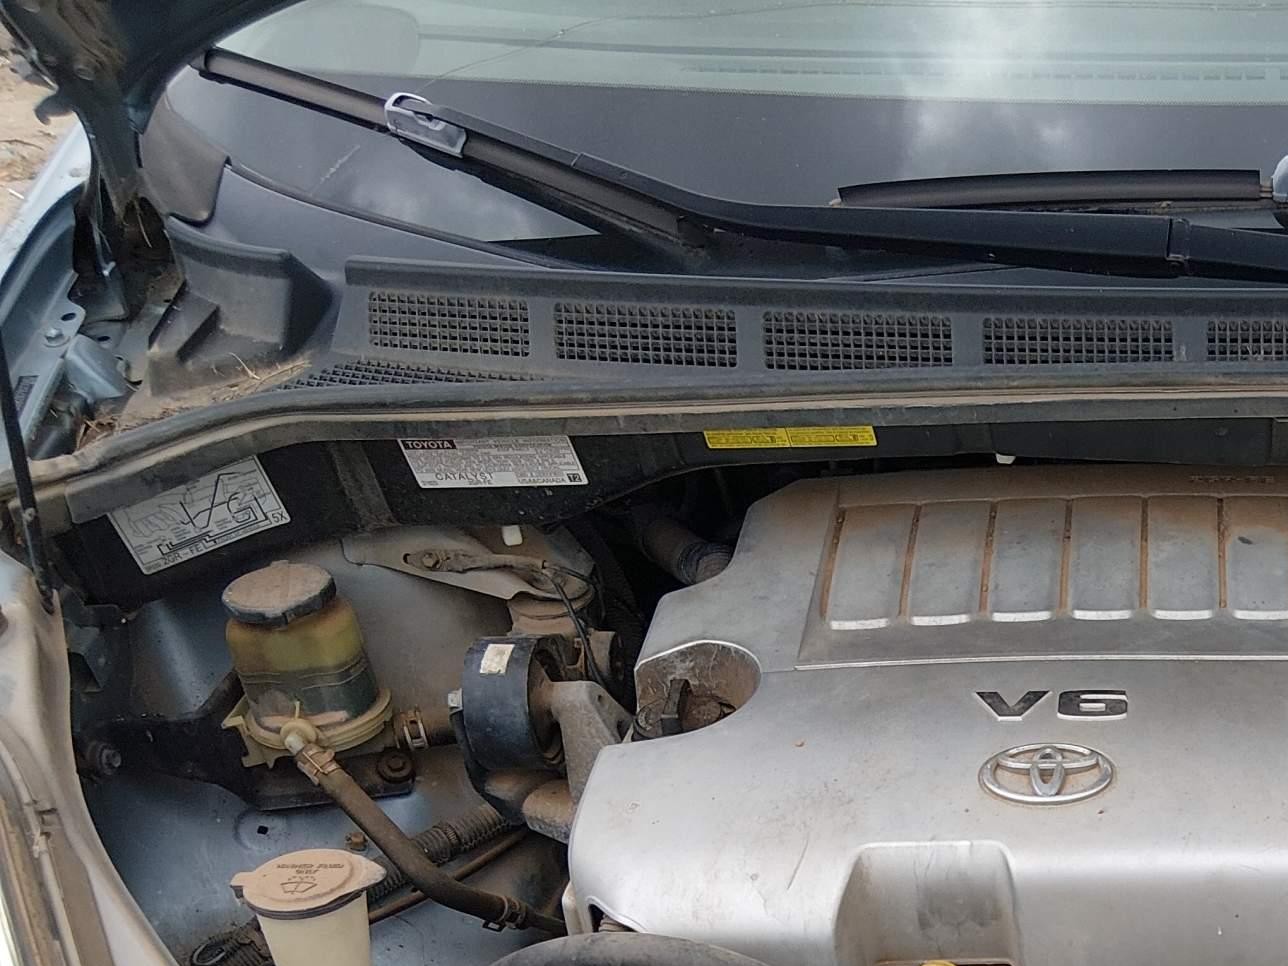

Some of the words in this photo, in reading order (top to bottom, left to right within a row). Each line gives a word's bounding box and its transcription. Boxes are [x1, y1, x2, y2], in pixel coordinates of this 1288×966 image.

[406, 440, 453, 449] TOYOTA
[435, 471, 494, 481] CATALYST
[271, 510, 288, 524] 5X
[974, 688, 1130, 722] V6
